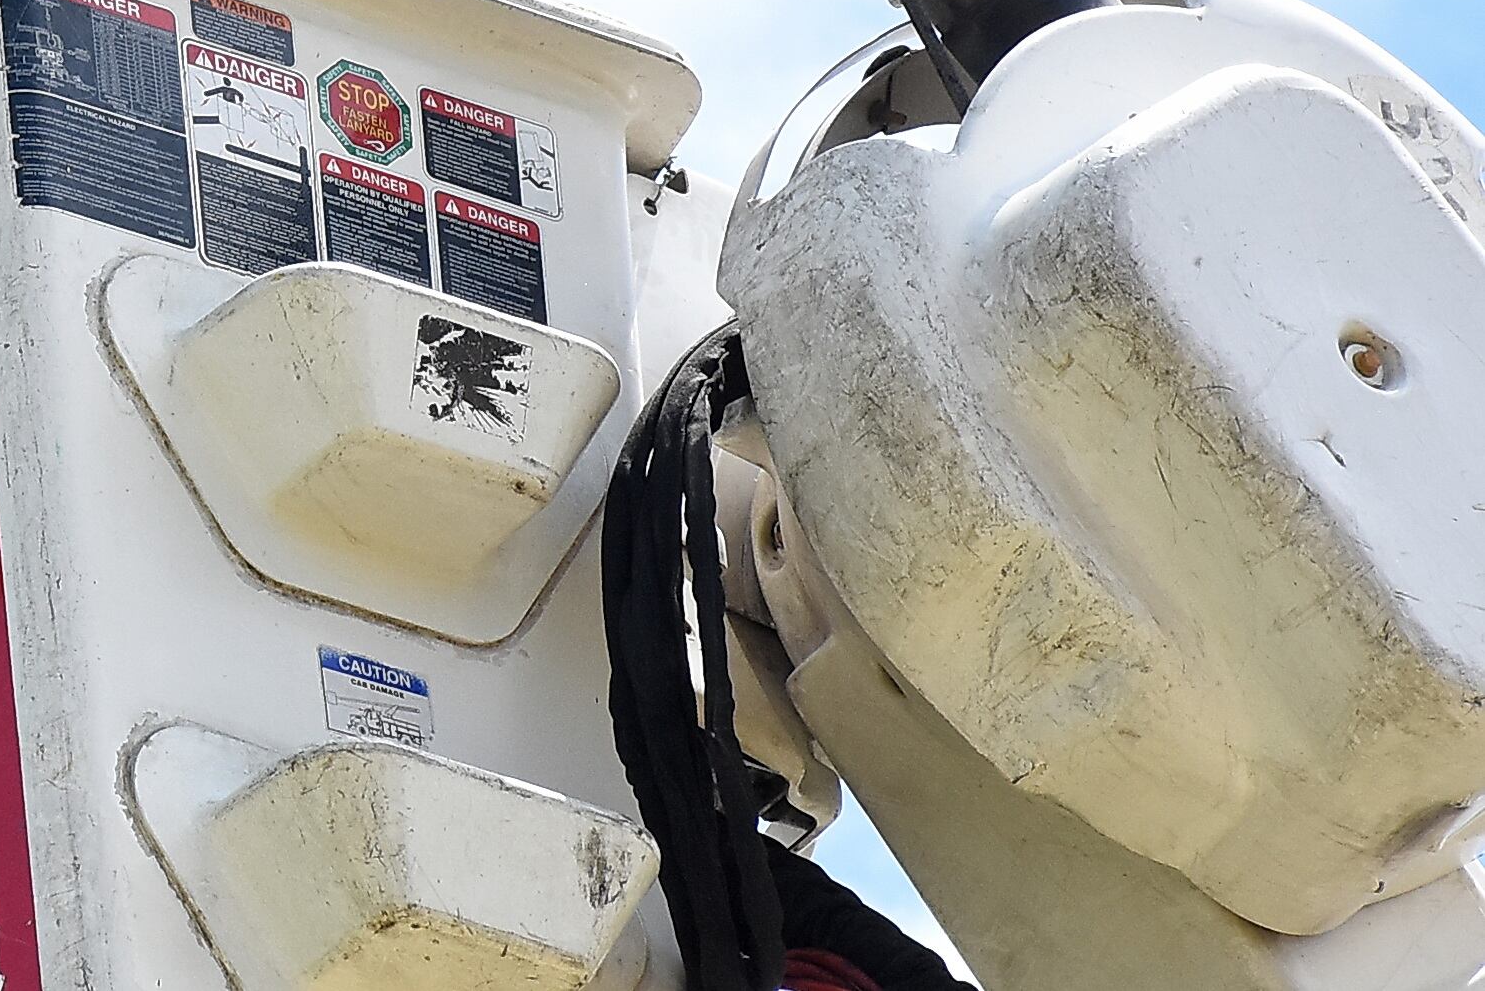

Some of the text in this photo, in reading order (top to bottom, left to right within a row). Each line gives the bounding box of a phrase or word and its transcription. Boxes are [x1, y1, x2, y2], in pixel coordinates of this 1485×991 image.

[214, 54, 298, 96] DANGER
[349, 63, 376, 78] SAFETY
[338, 80, 390, 112] STOP
[381, 79, 405, 106] SAFETY
[66, 105, 136, 131] ELECTRICAL HAZARD
[343, 106, 387, 129] FASTEN
[443, 99, 504, 130] DANGER
[449, 119, 466, 129] FALL
[326, 118, 350, 146] SAFETY
[338, 115, 394, 143] LANYARD
[355, 149, 383, 163] SAFETY
[323, 174, 424, 213] OPERATION BY QUALIFIED
[351, 166, 409, 196] DANGER
[339, 189, 410, 217] PERSONNEL ONLY
[467, 206, 529, 236] DANGER
[338, 656, 412, 689] CAUTION
[370, 683, 405, 699] DAMAGE
